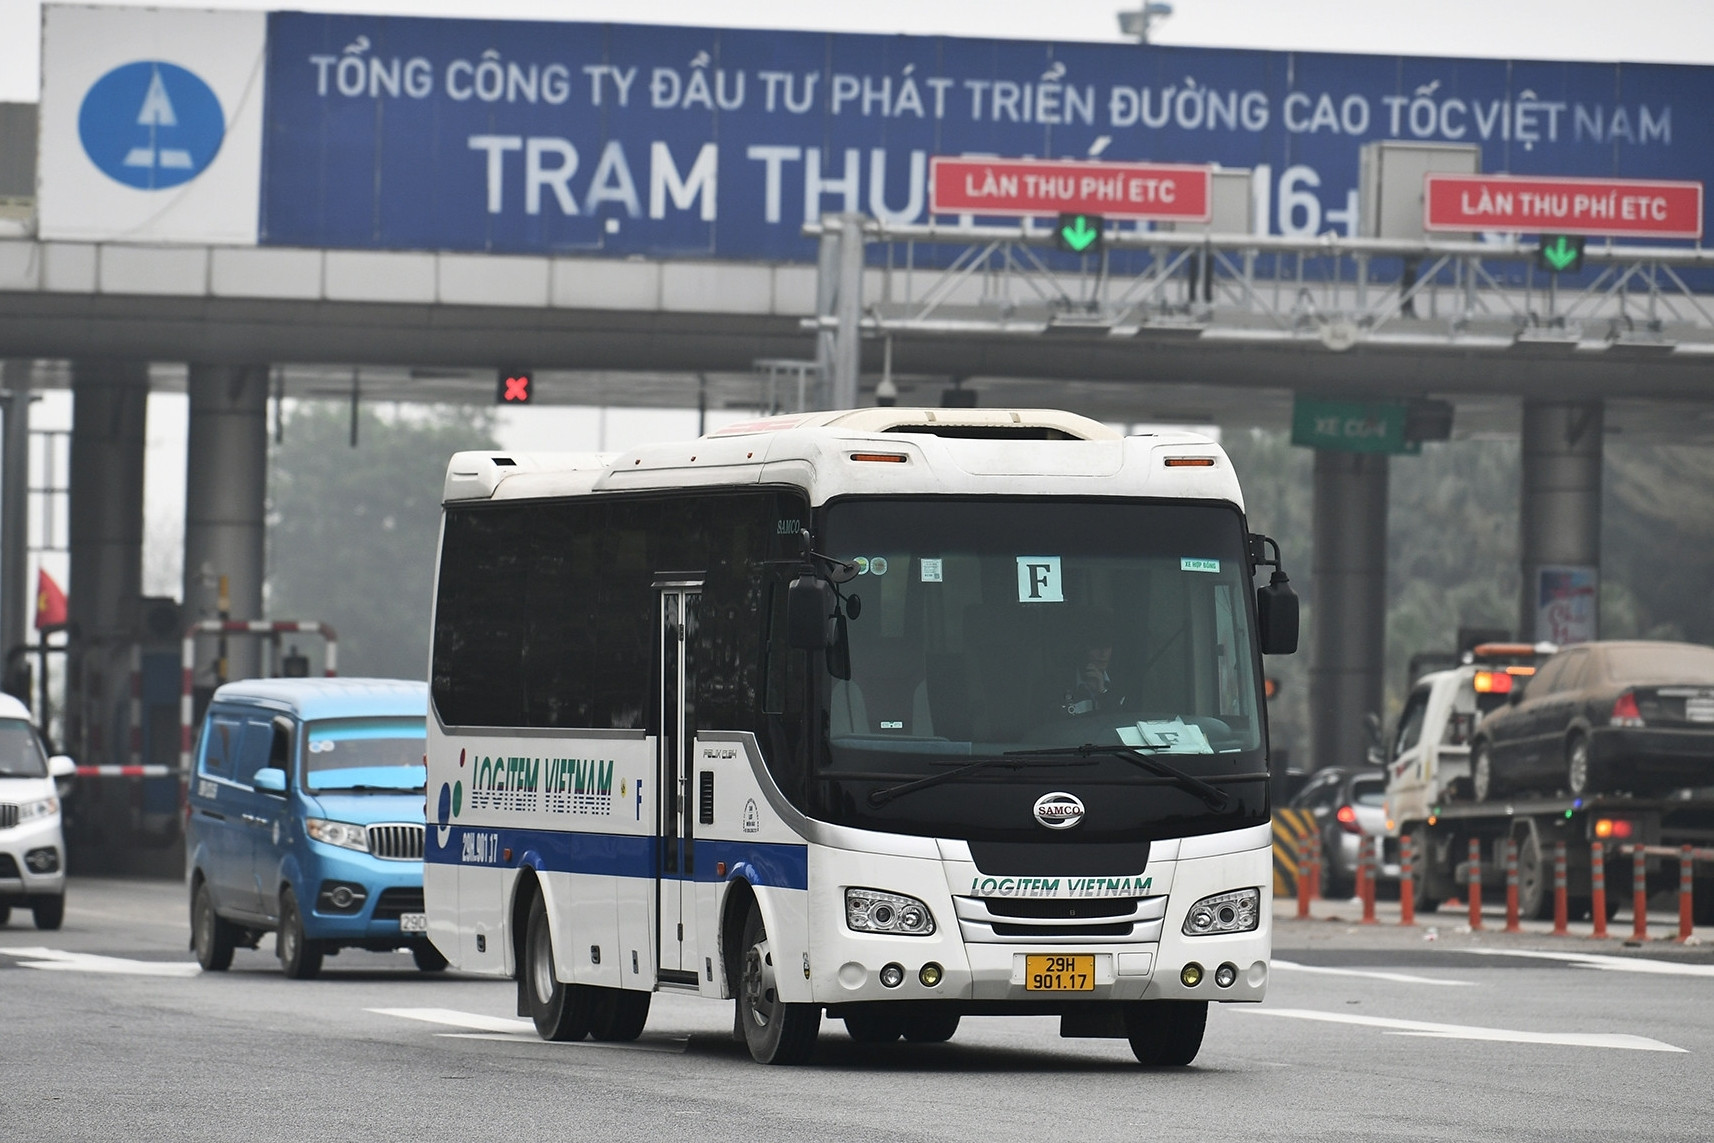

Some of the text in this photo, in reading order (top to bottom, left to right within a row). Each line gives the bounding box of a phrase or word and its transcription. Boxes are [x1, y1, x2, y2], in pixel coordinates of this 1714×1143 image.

[309, 35, 1673, 151] TỔNG CÔNG TY ĐẦU TƯ PHÁT TRIỂN ĐƯỜNG CAO TỐC VIỆT NAM
[467, 135, 718, 233] TRẠM
[747, 145, 926, 226] THU
[964, 168, 1176, 203] LÀN THU PHÍ ETC
[1460, 184, 1667, 221] LÀN THU PHÍ ETC
[1026, 564, 1051, 598] F
[472, 756, 614, 815] LOGITEM VIETNAM
[636, 779, 643, 821] F
[1038, 806, 1082, 815] SAMCO
[970, 877, 1152, 897] LOGITEM VIETNAM
[1033, 974, 1087, 989] 901.17
[1046, 957, 1075, 972] 29H
